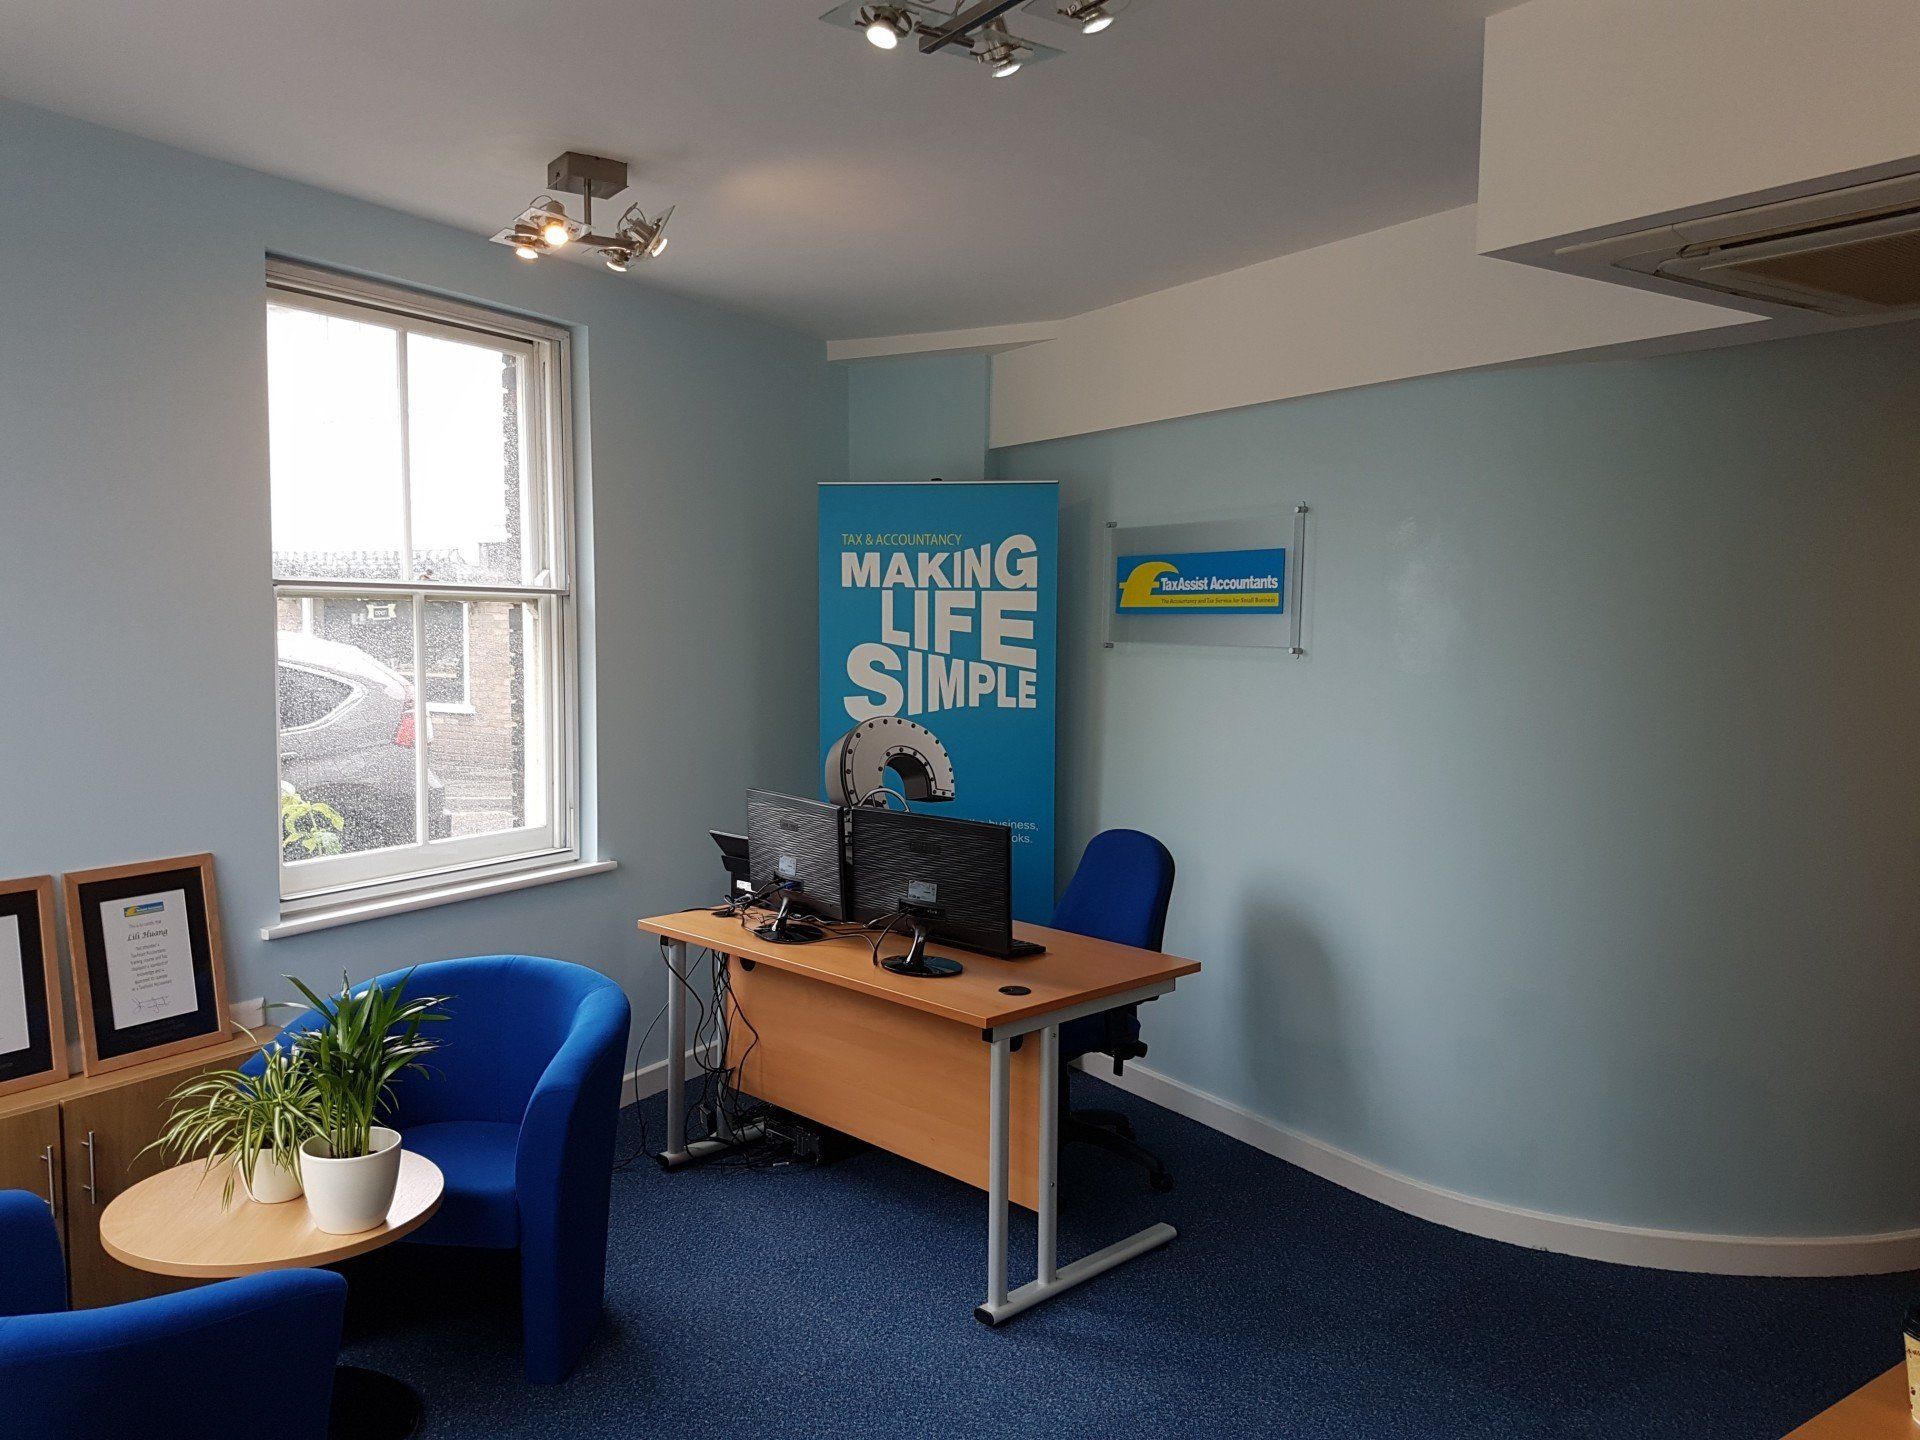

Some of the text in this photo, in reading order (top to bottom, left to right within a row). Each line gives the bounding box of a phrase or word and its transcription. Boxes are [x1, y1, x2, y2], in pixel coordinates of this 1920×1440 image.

[842, 533, 962, 546] TAX & ACCOUNTANCY
[841, 534, 1038, 590] MAKING
[1161, 575, 1278, 591] TaxAssist Accountants
[881, 590, 1038, 670] LIFE
[843, 642, 1037, 722] SIMPLE
[1011, 834, 1033, 843] oks.
[142, 929, 168, 939] Huang
